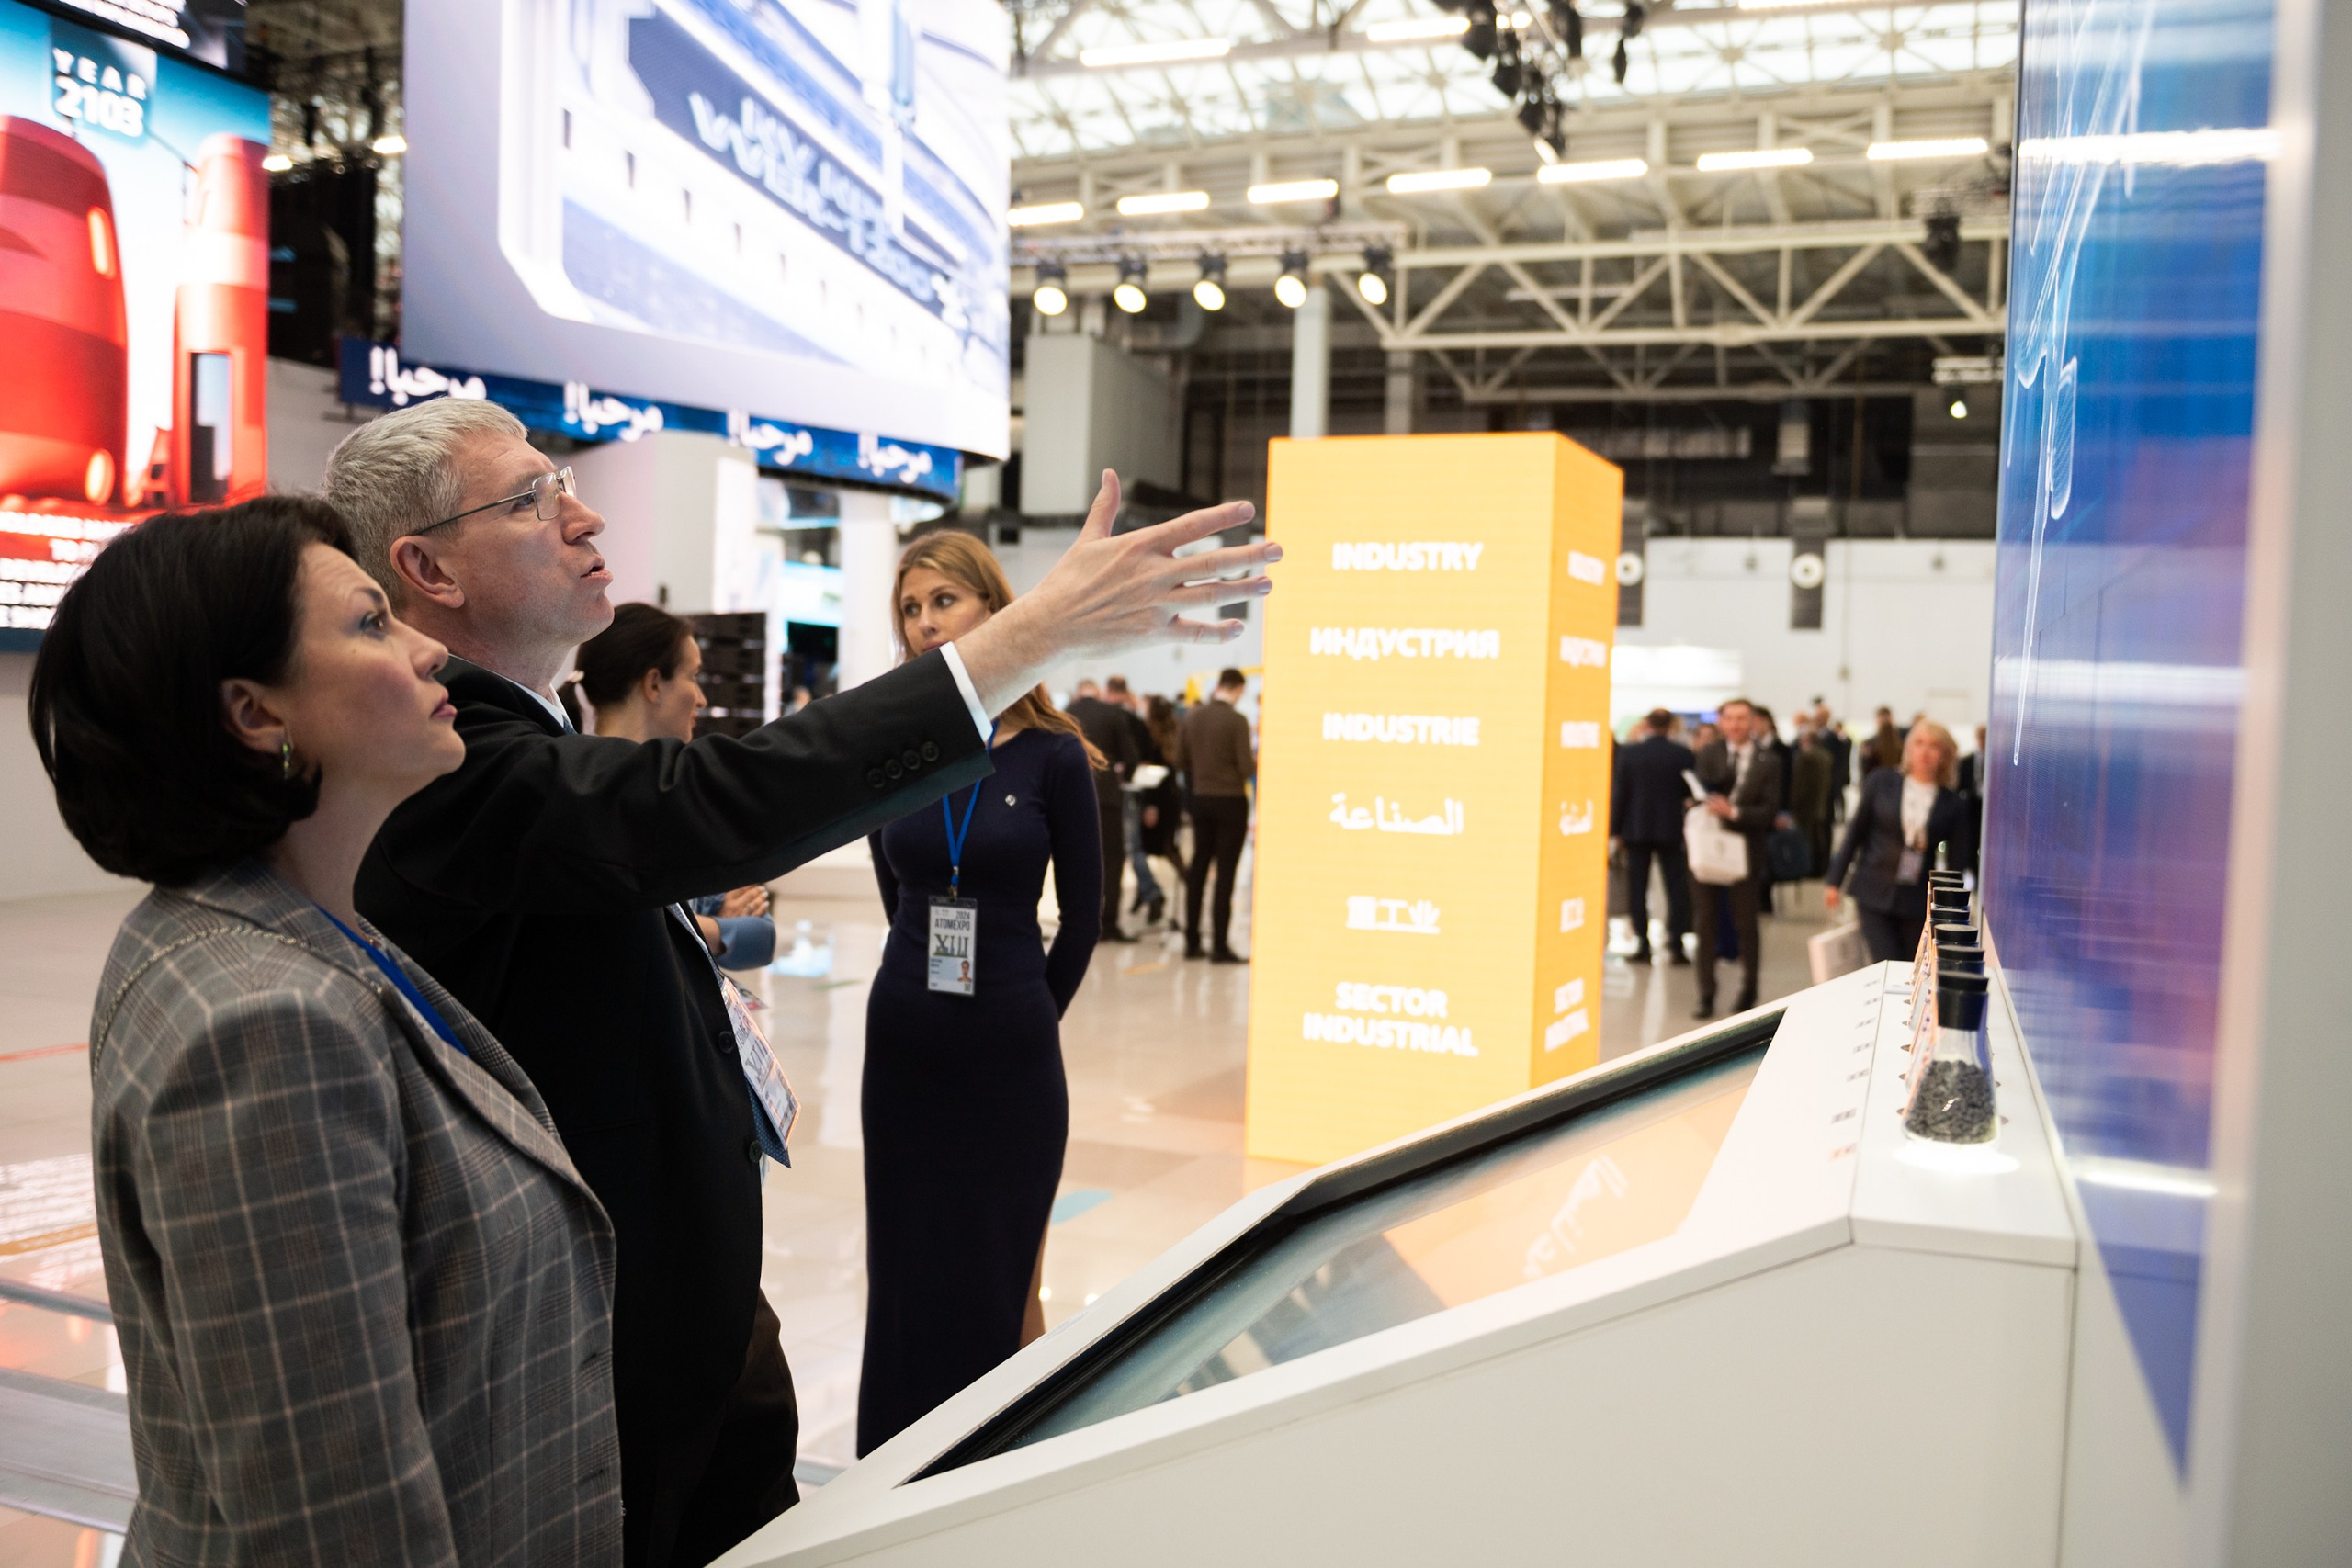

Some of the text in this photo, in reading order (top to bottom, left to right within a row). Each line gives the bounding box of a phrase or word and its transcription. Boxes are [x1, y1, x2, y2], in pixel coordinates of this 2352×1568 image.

[52, 47, 147, 101] YEAR
[54, 74, 144, 137] 2103
[1331, 542, 1484, 571] INDUSTRY
[1310, 627, 1500, 660] ИНДУСТРИЯ
[1322, 713, 1481, 746] INDUSTRIE
[1329, 792, 1464, 835] الصناعة
[934, 919, 970, 931] ATOMEXPO
[956, 910, 970, 919] 2024
[1335, 981, 1448, 1018] SECTOR
[1303, 1012, 1479, 1056] INDUSTRIAL
